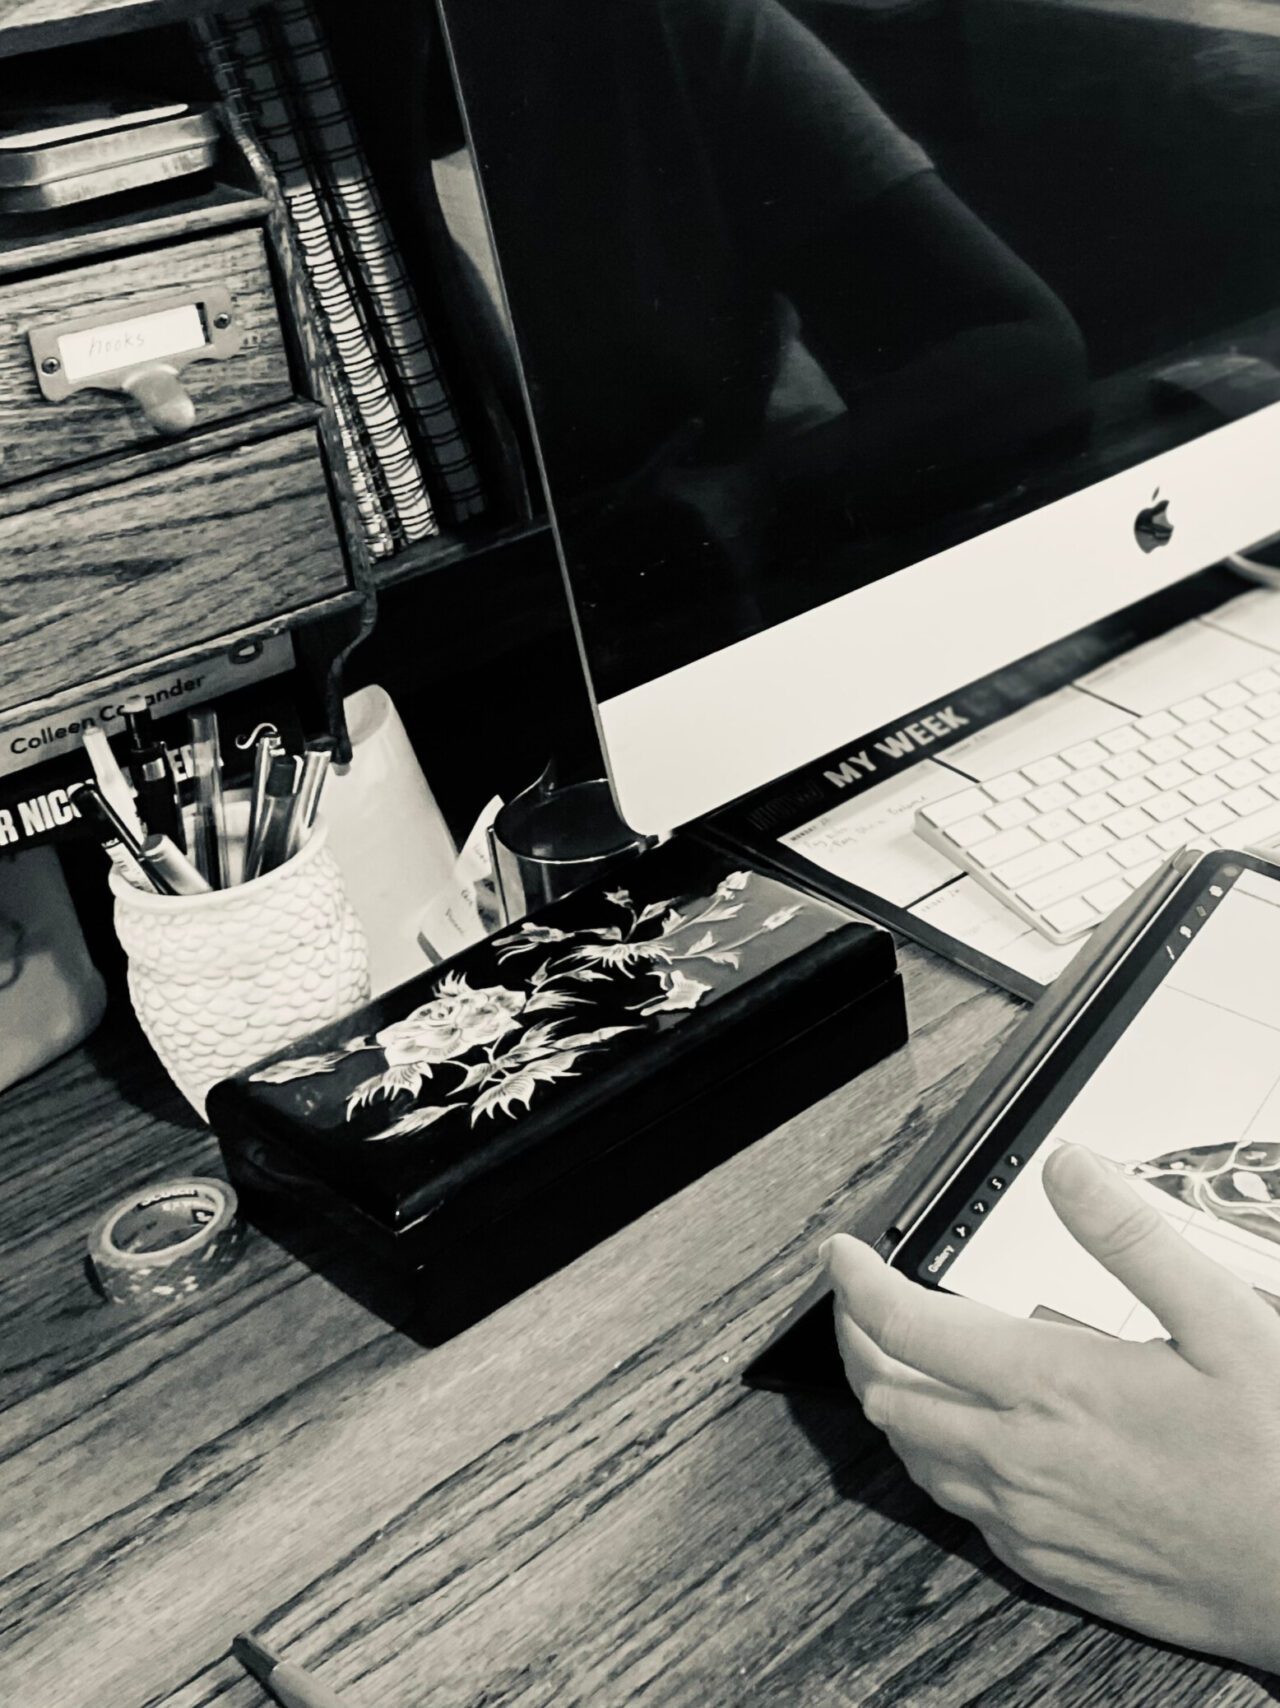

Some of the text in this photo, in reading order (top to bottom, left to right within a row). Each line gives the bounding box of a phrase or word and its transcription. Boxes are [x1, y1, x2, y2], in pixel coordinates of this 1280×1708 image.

[10, 717, 95, 754] Colleen
[822, 750, 877, 788] MY
[873, 706, 970, 759] WEEK
